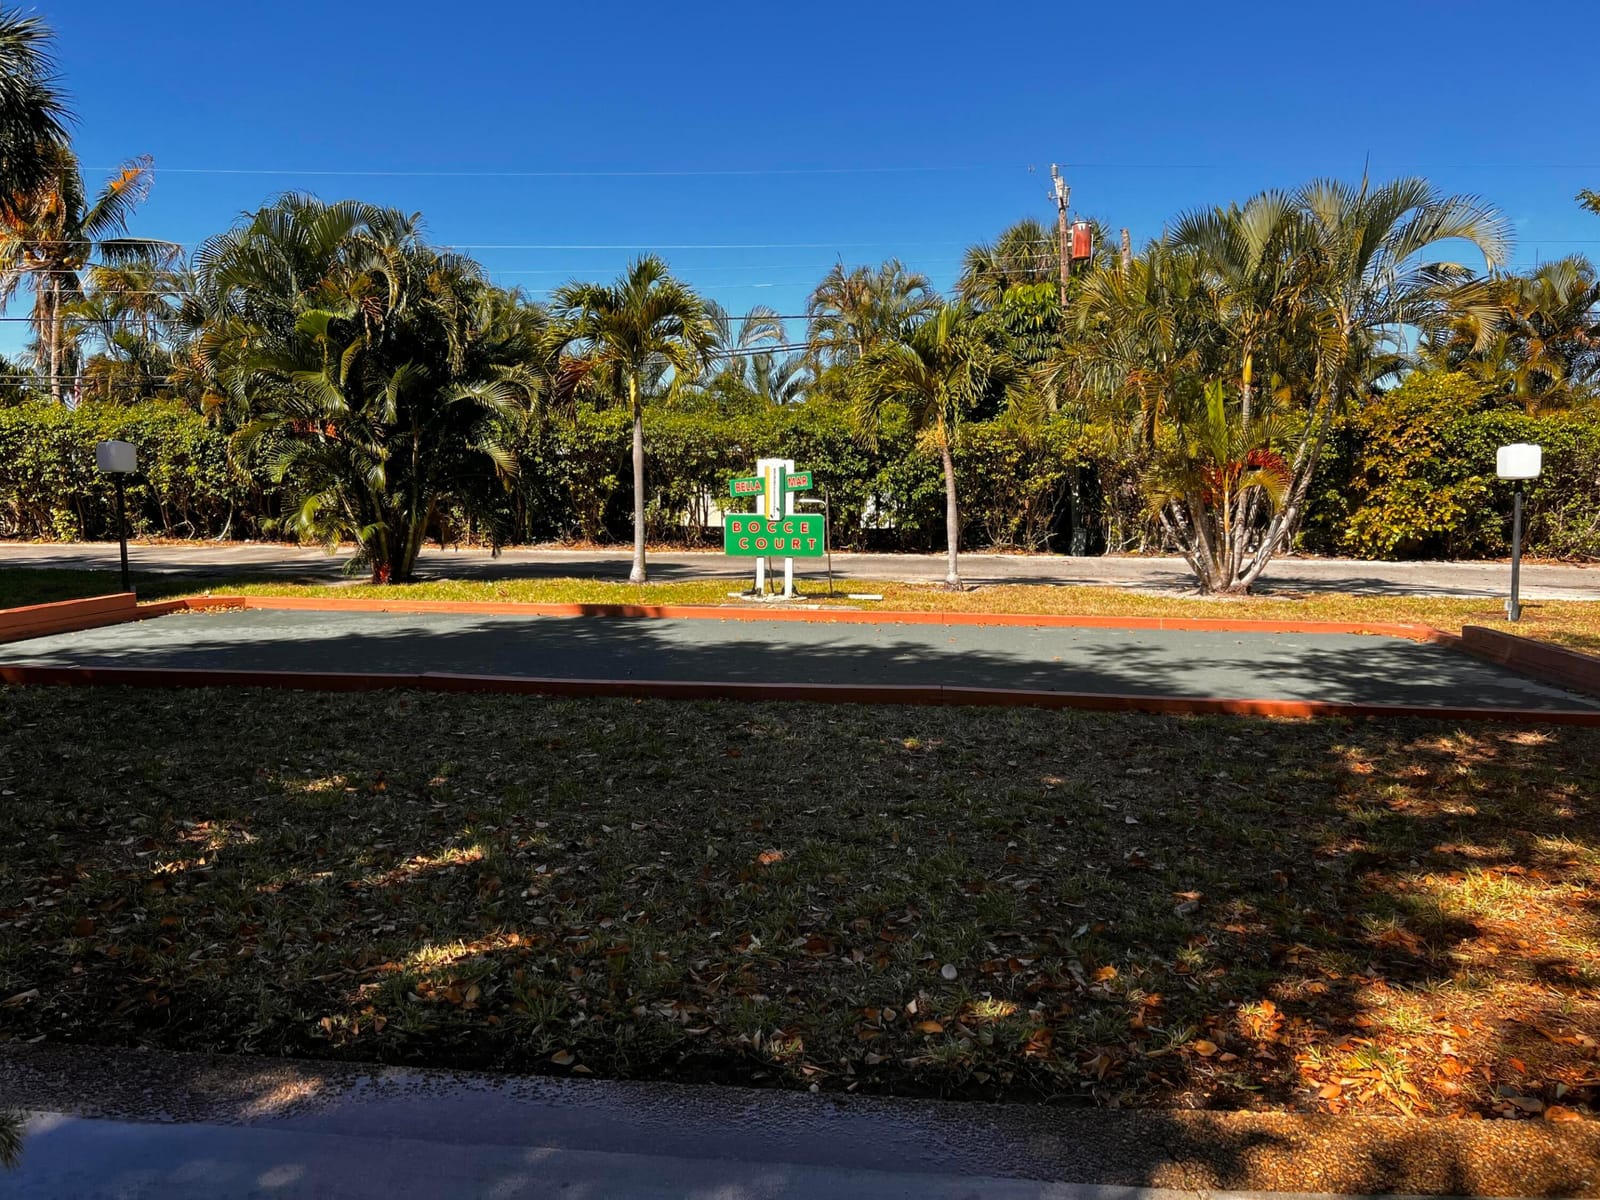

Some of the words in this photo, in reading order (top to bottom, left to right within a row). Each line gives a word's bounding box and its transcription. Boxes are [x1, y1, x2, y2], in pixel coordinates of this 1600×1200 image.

[735, 480, 762, 493] BELLA
[787, 475, 808, 488] MAR
[732, 521, 809, 534] BOCCE
[739, 538, 816, 550] COURT
